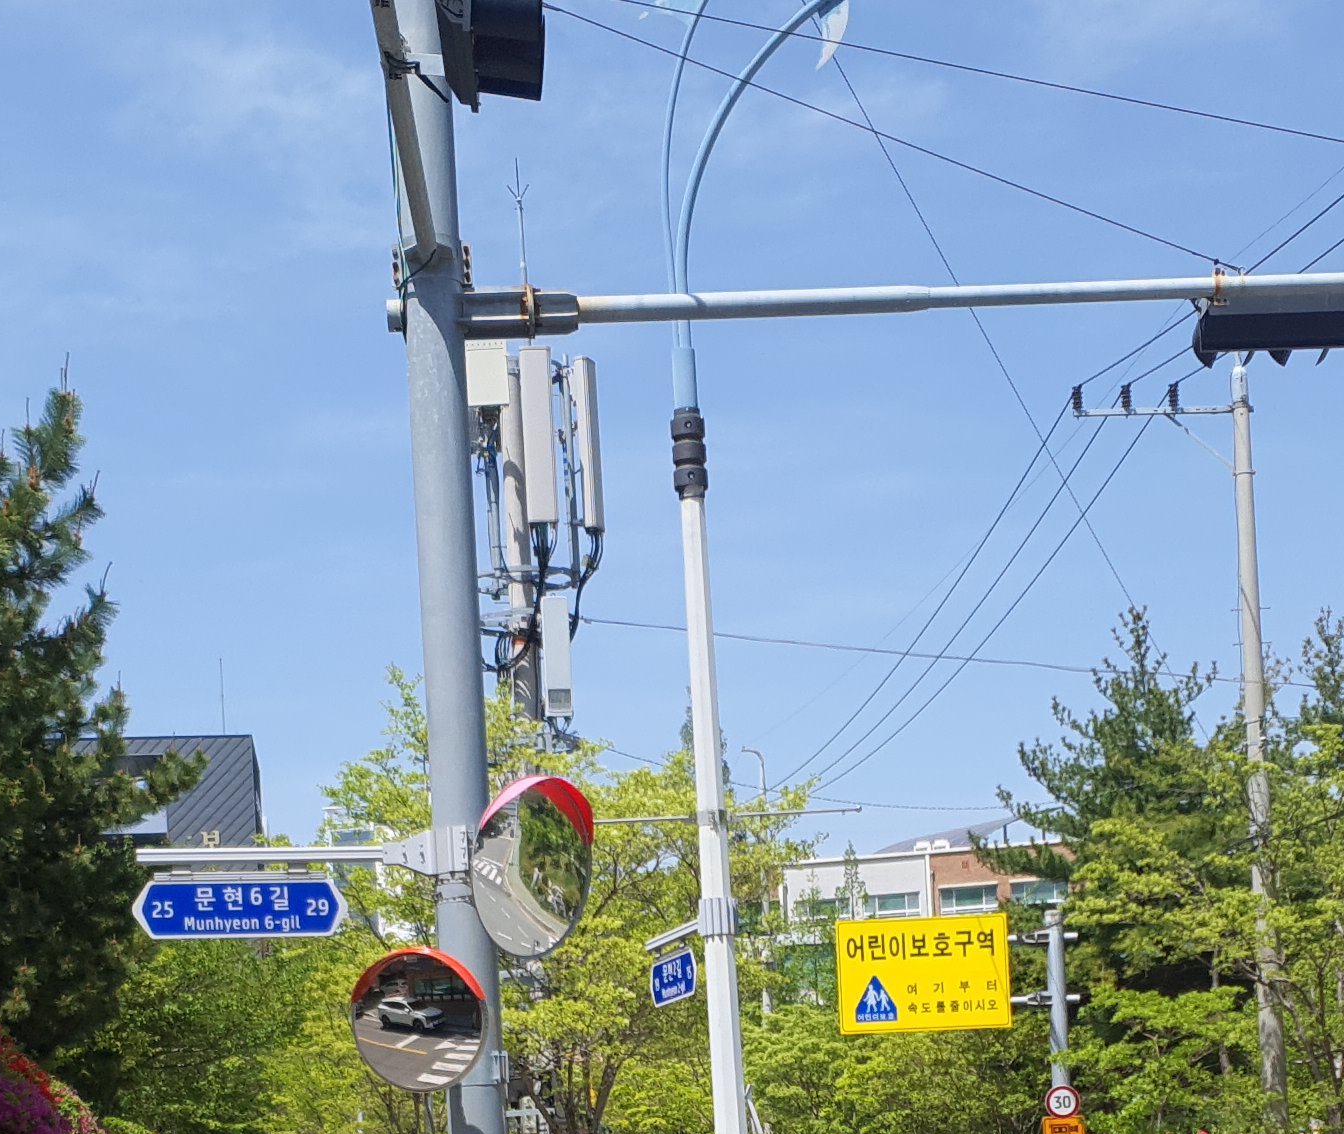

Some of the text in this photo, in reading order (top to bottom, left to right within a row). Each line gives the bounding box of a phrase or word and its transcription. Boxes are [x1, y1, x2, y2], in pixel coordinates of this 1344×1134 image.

[152, 902, 174, 919] 25
[306, 899, 329, 916] 29
[184, 915, 301, 932] Munhyeon 6-gil
[846, 929, 995, 962] 어린이보호구역
[1054, 1096, 1071, 1109] 30
